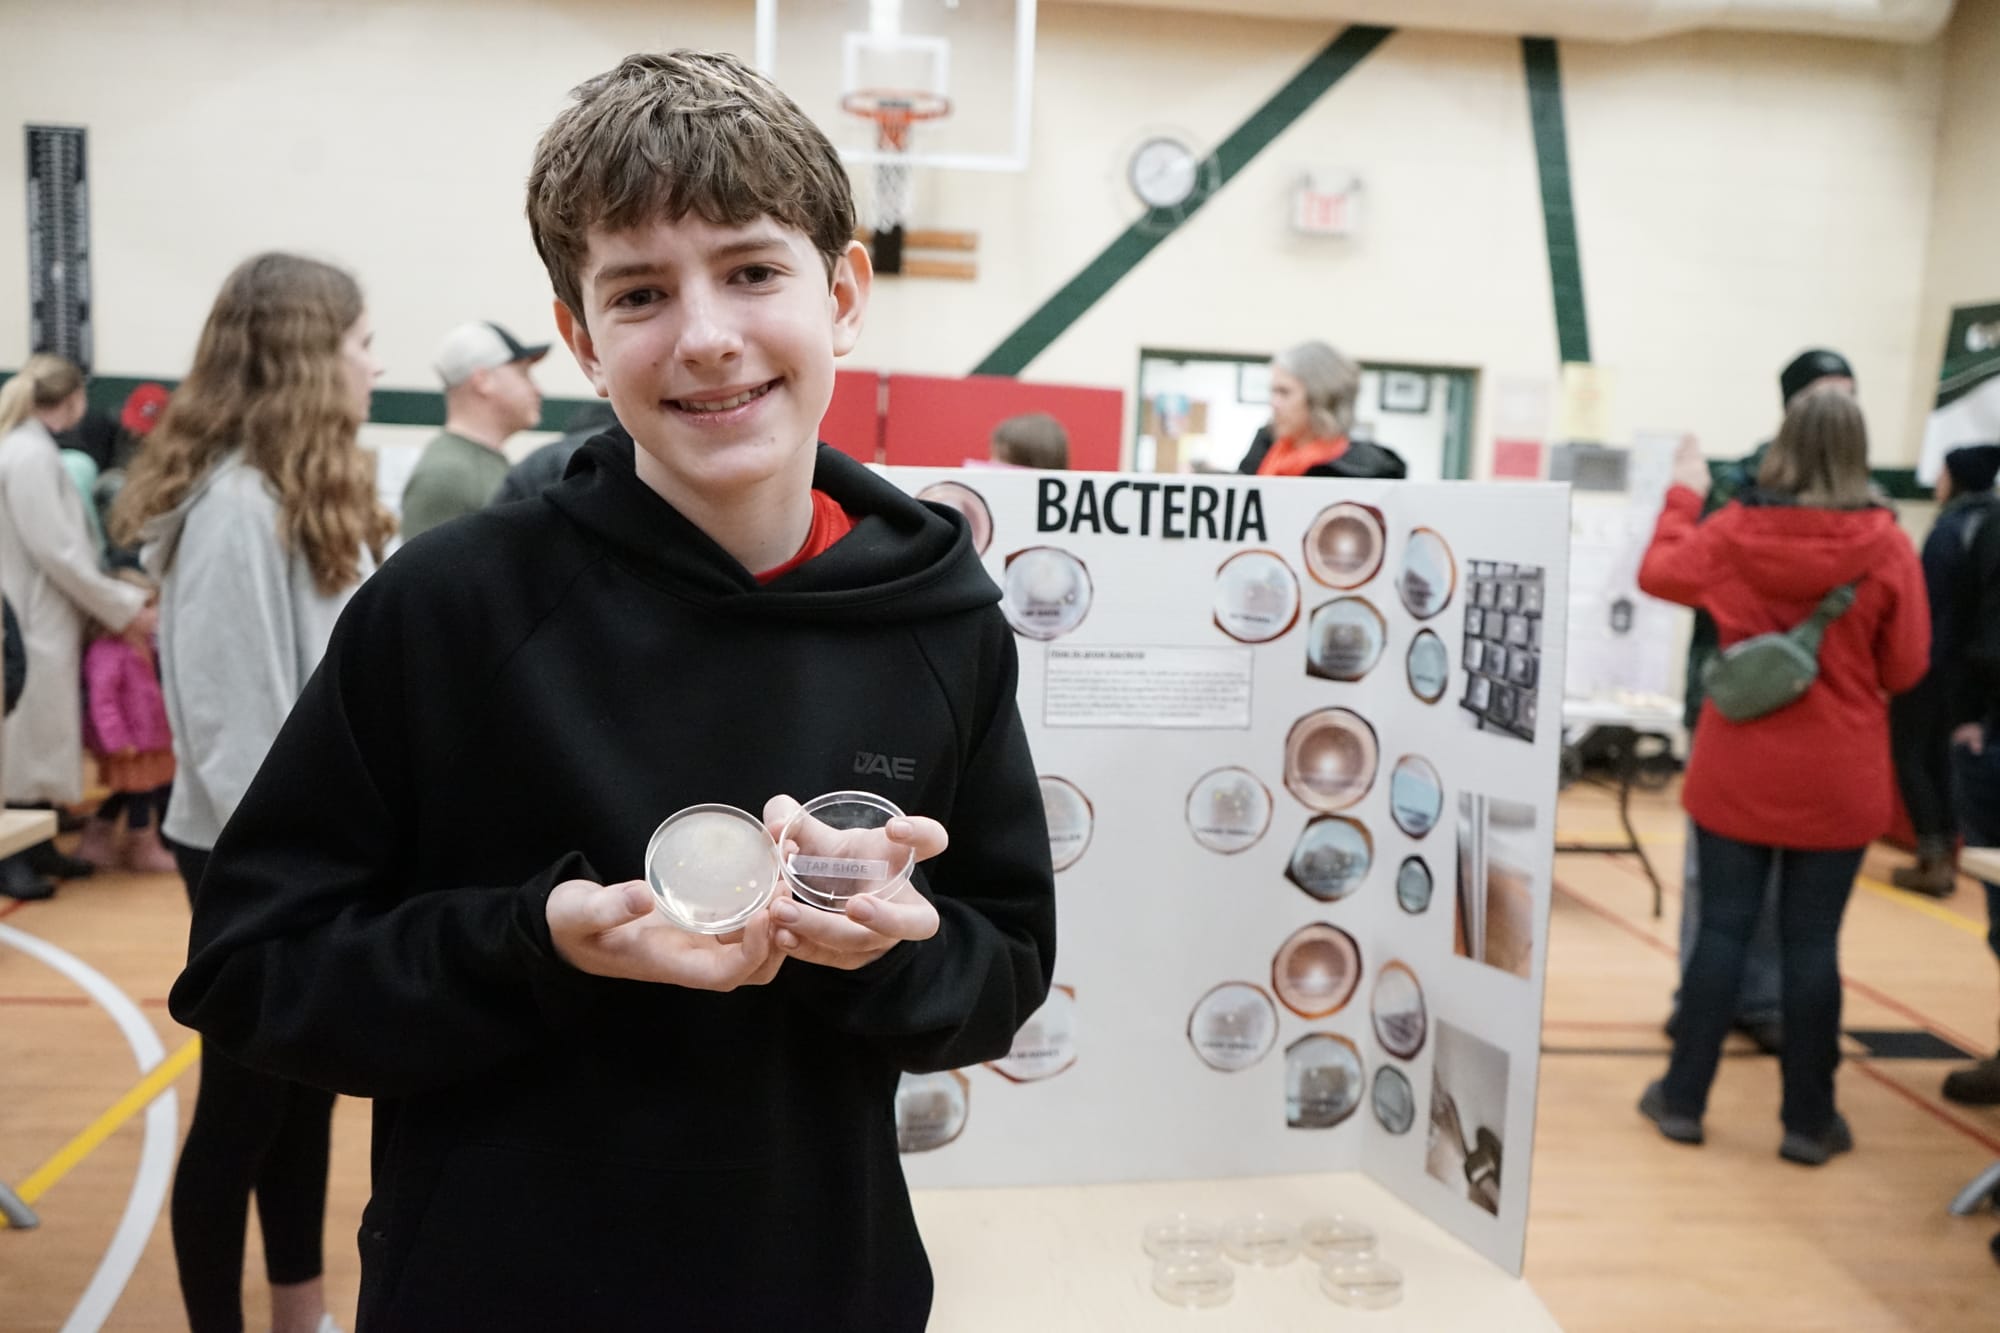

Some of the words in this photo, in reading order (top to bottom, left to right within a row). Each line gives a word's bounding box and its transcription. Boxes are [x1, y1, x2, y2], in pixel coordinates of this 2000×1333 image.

[1037, 478, 1267, 541] BACTERIA
[805, 861, 829, 873] TAP
[832, 863, 869, 874] SHOE
